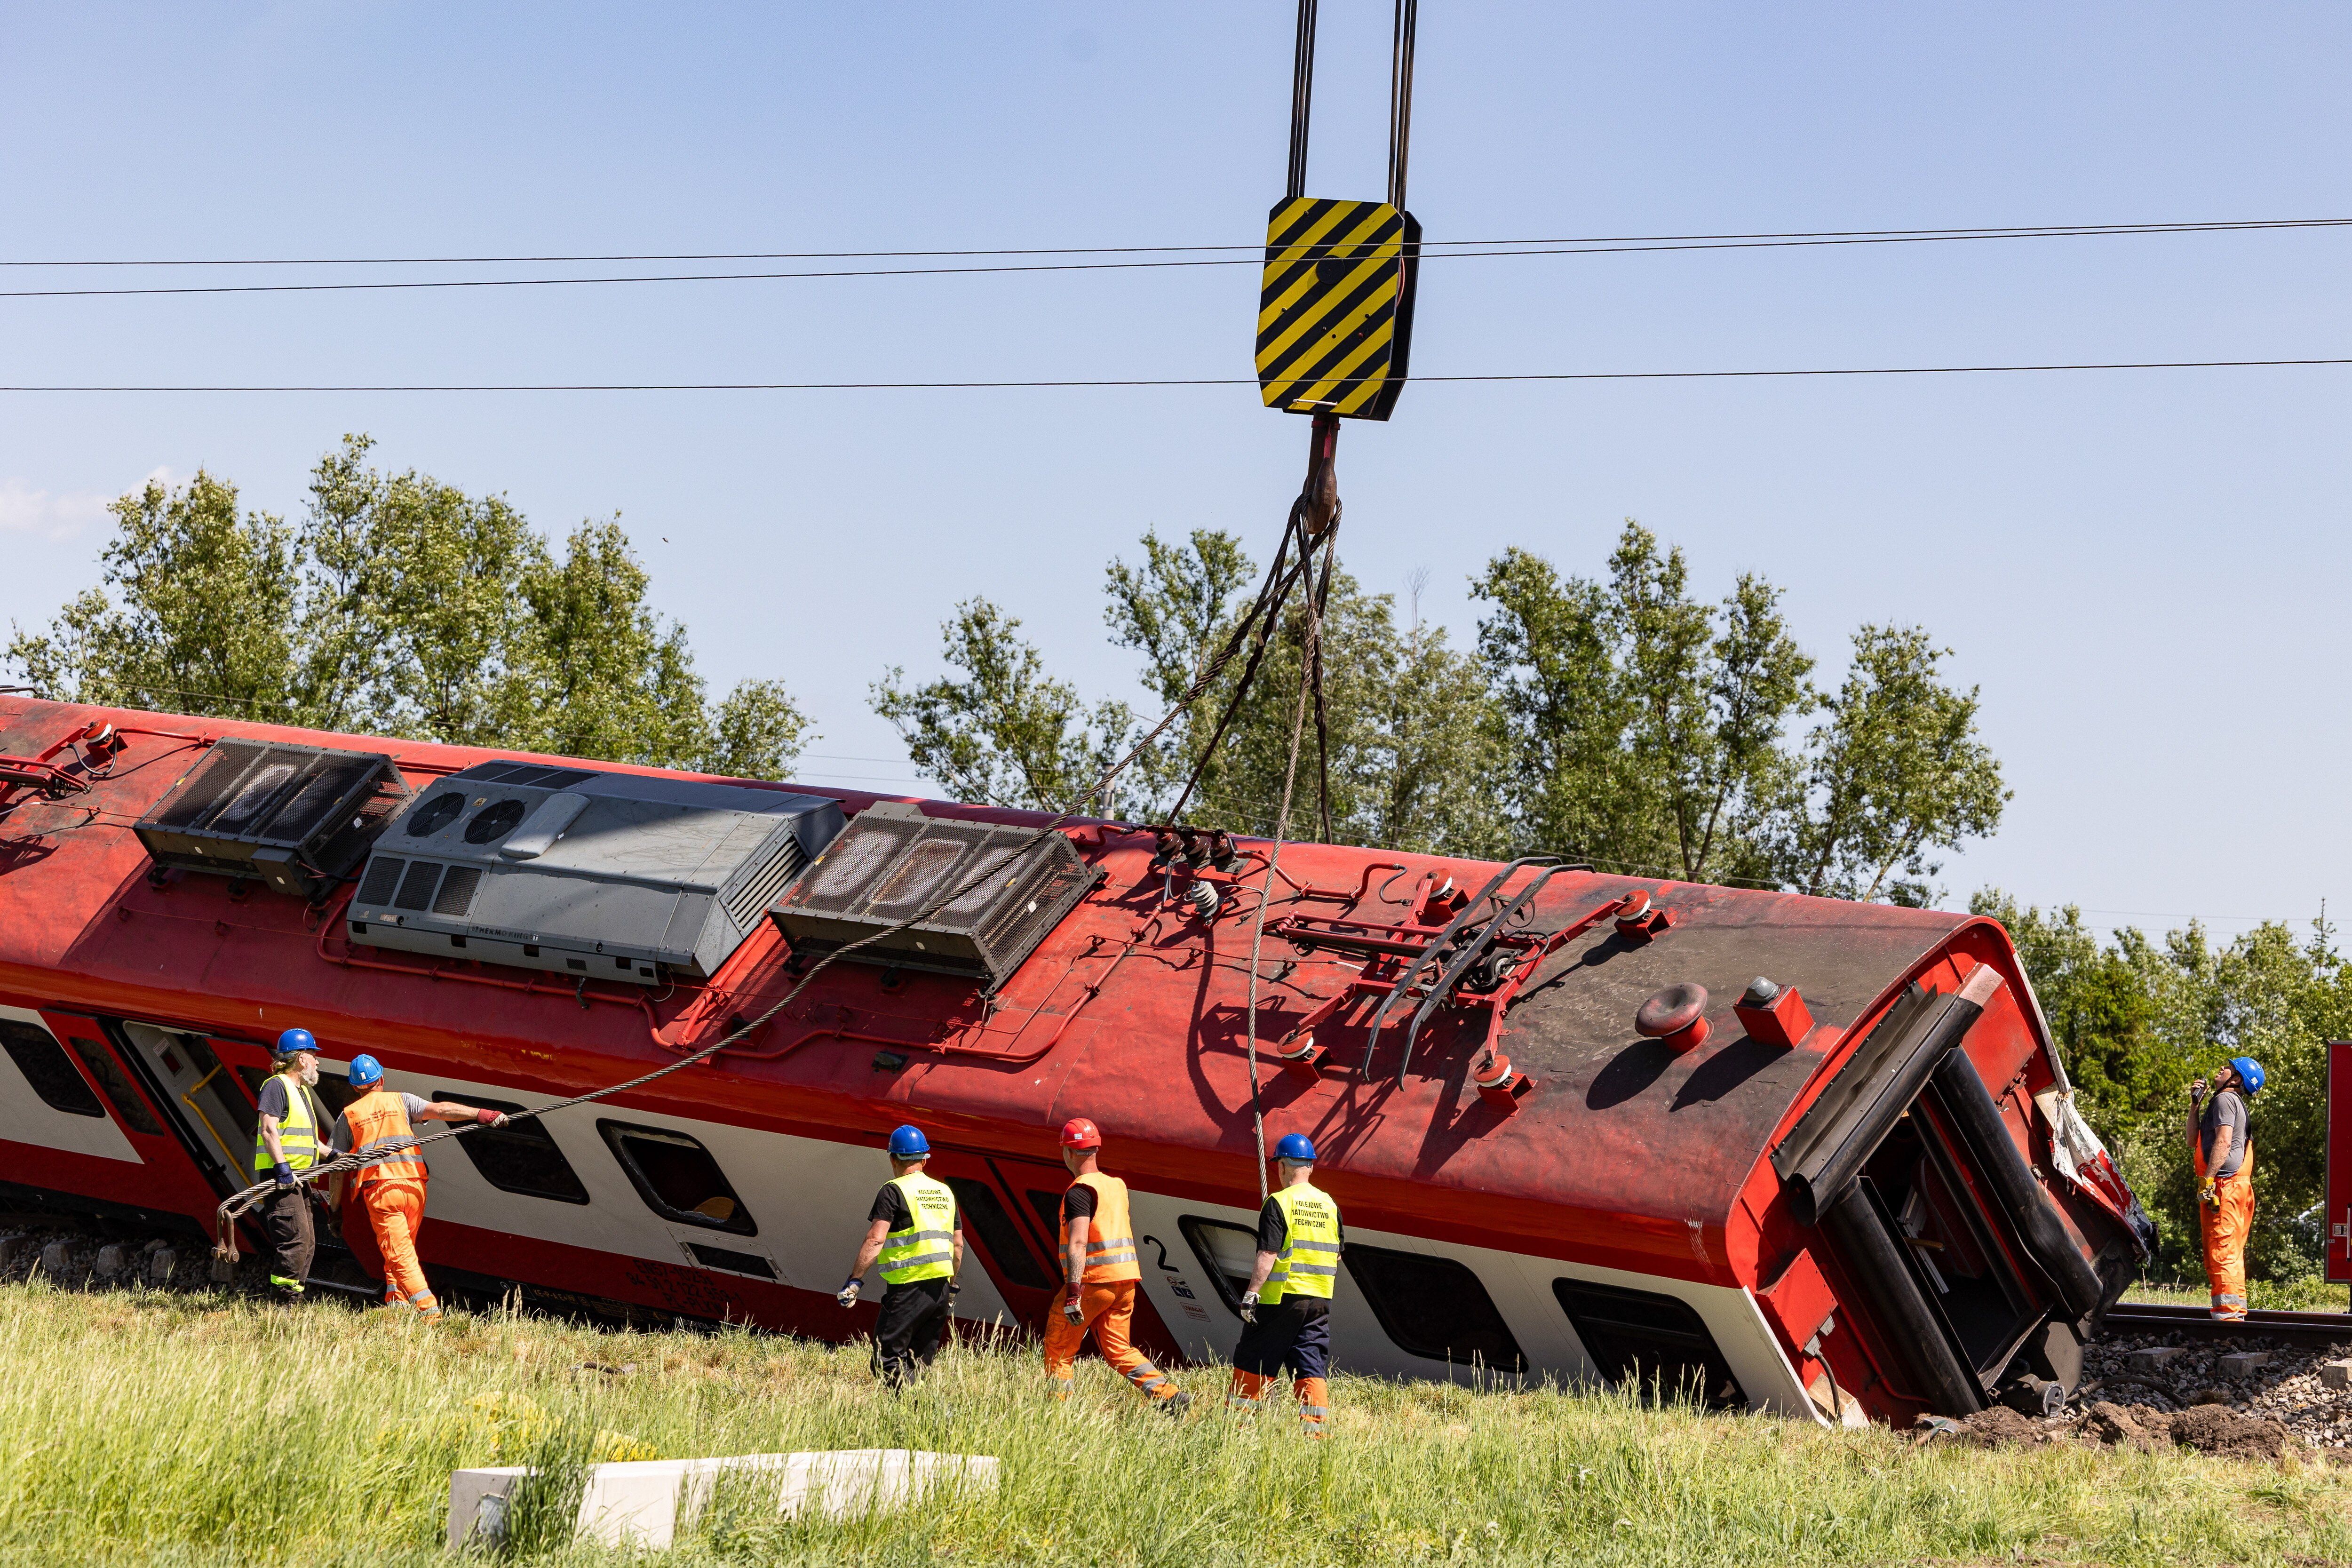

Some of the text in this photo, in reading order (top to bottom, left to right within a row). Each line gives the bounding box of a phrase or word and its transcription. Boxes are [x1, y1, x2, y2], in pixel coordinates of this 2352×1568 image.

[1294, 1218, 1326, 1228] TECHNICZNE
[1143, 1234, 1180, 1273] 2
[663, 1278, 678, 1293] 2
